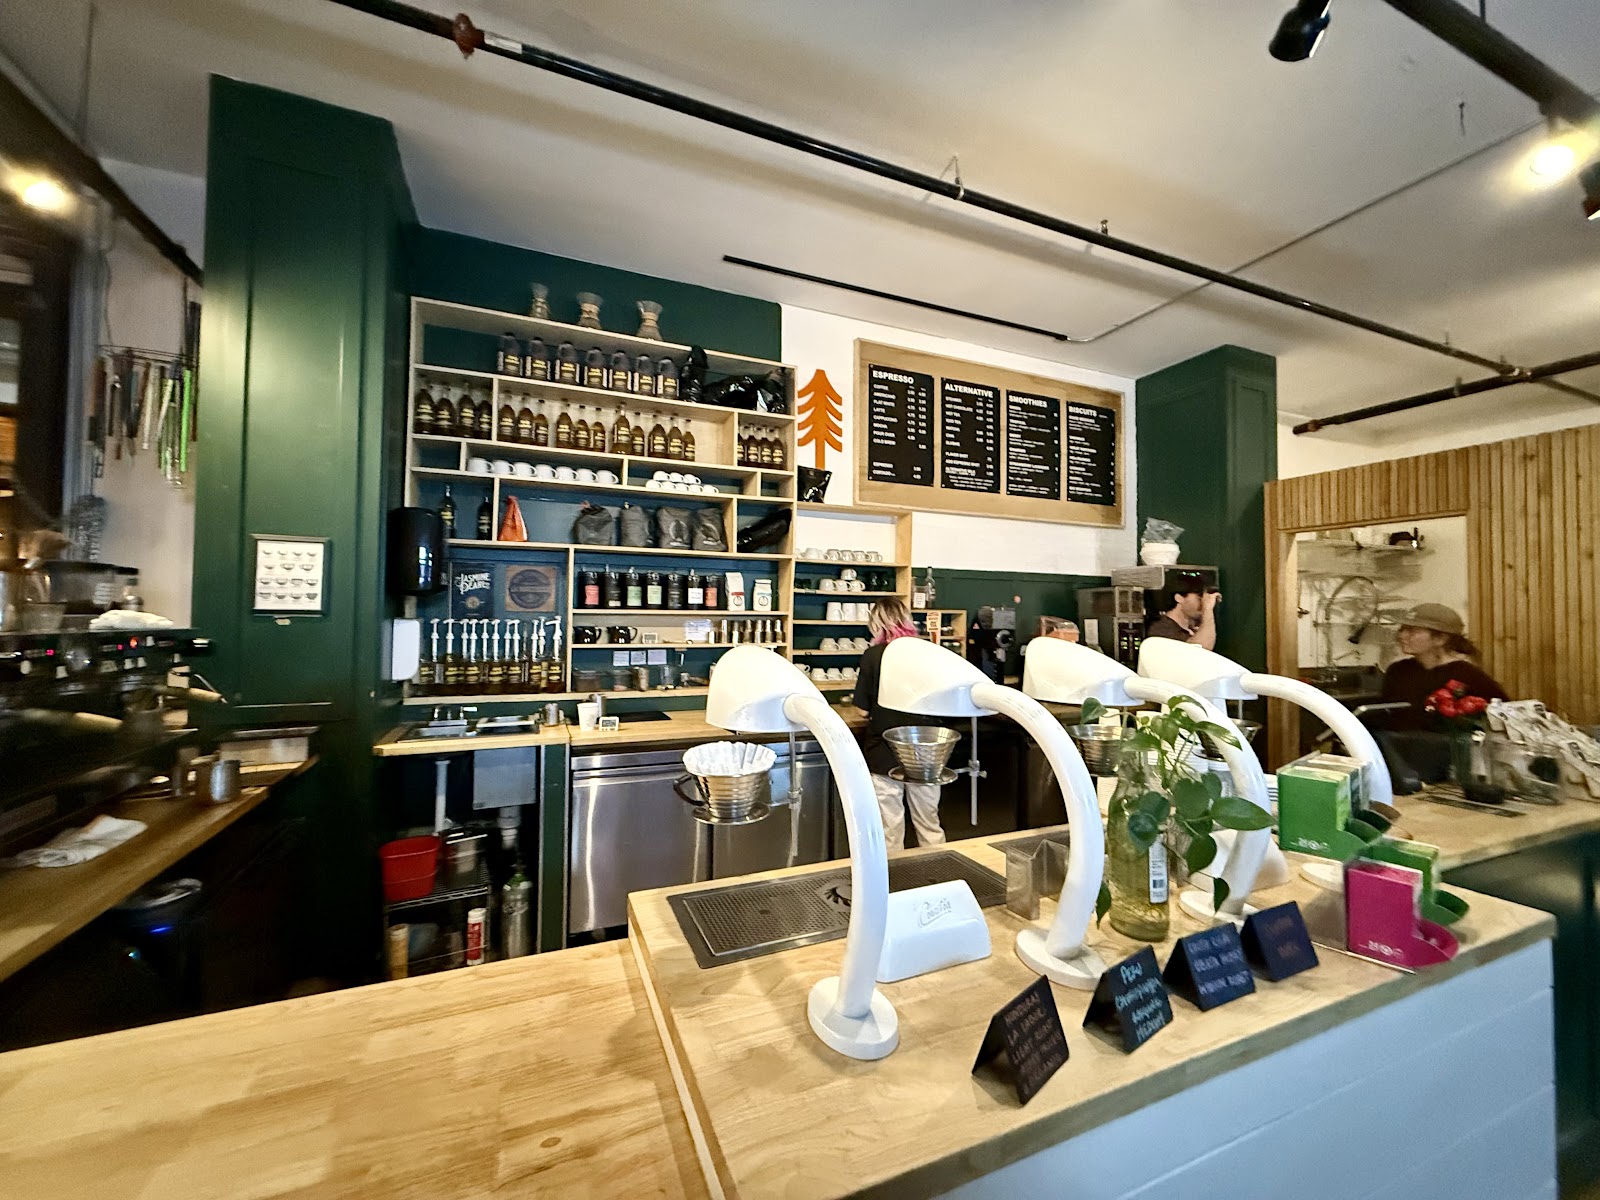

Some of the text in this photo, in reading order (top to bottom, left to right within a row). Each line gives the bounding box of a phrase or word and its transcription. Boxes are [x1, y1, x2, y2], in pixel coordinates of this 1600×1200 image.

[872, 370, 914, 384] ESPRESSO
[945, 383, 993, 398] ALTERNATIVE
[1008, 395, 1048, 408] SMOOTHIES
[1068, 406, 1097, 417] BISCUITS
